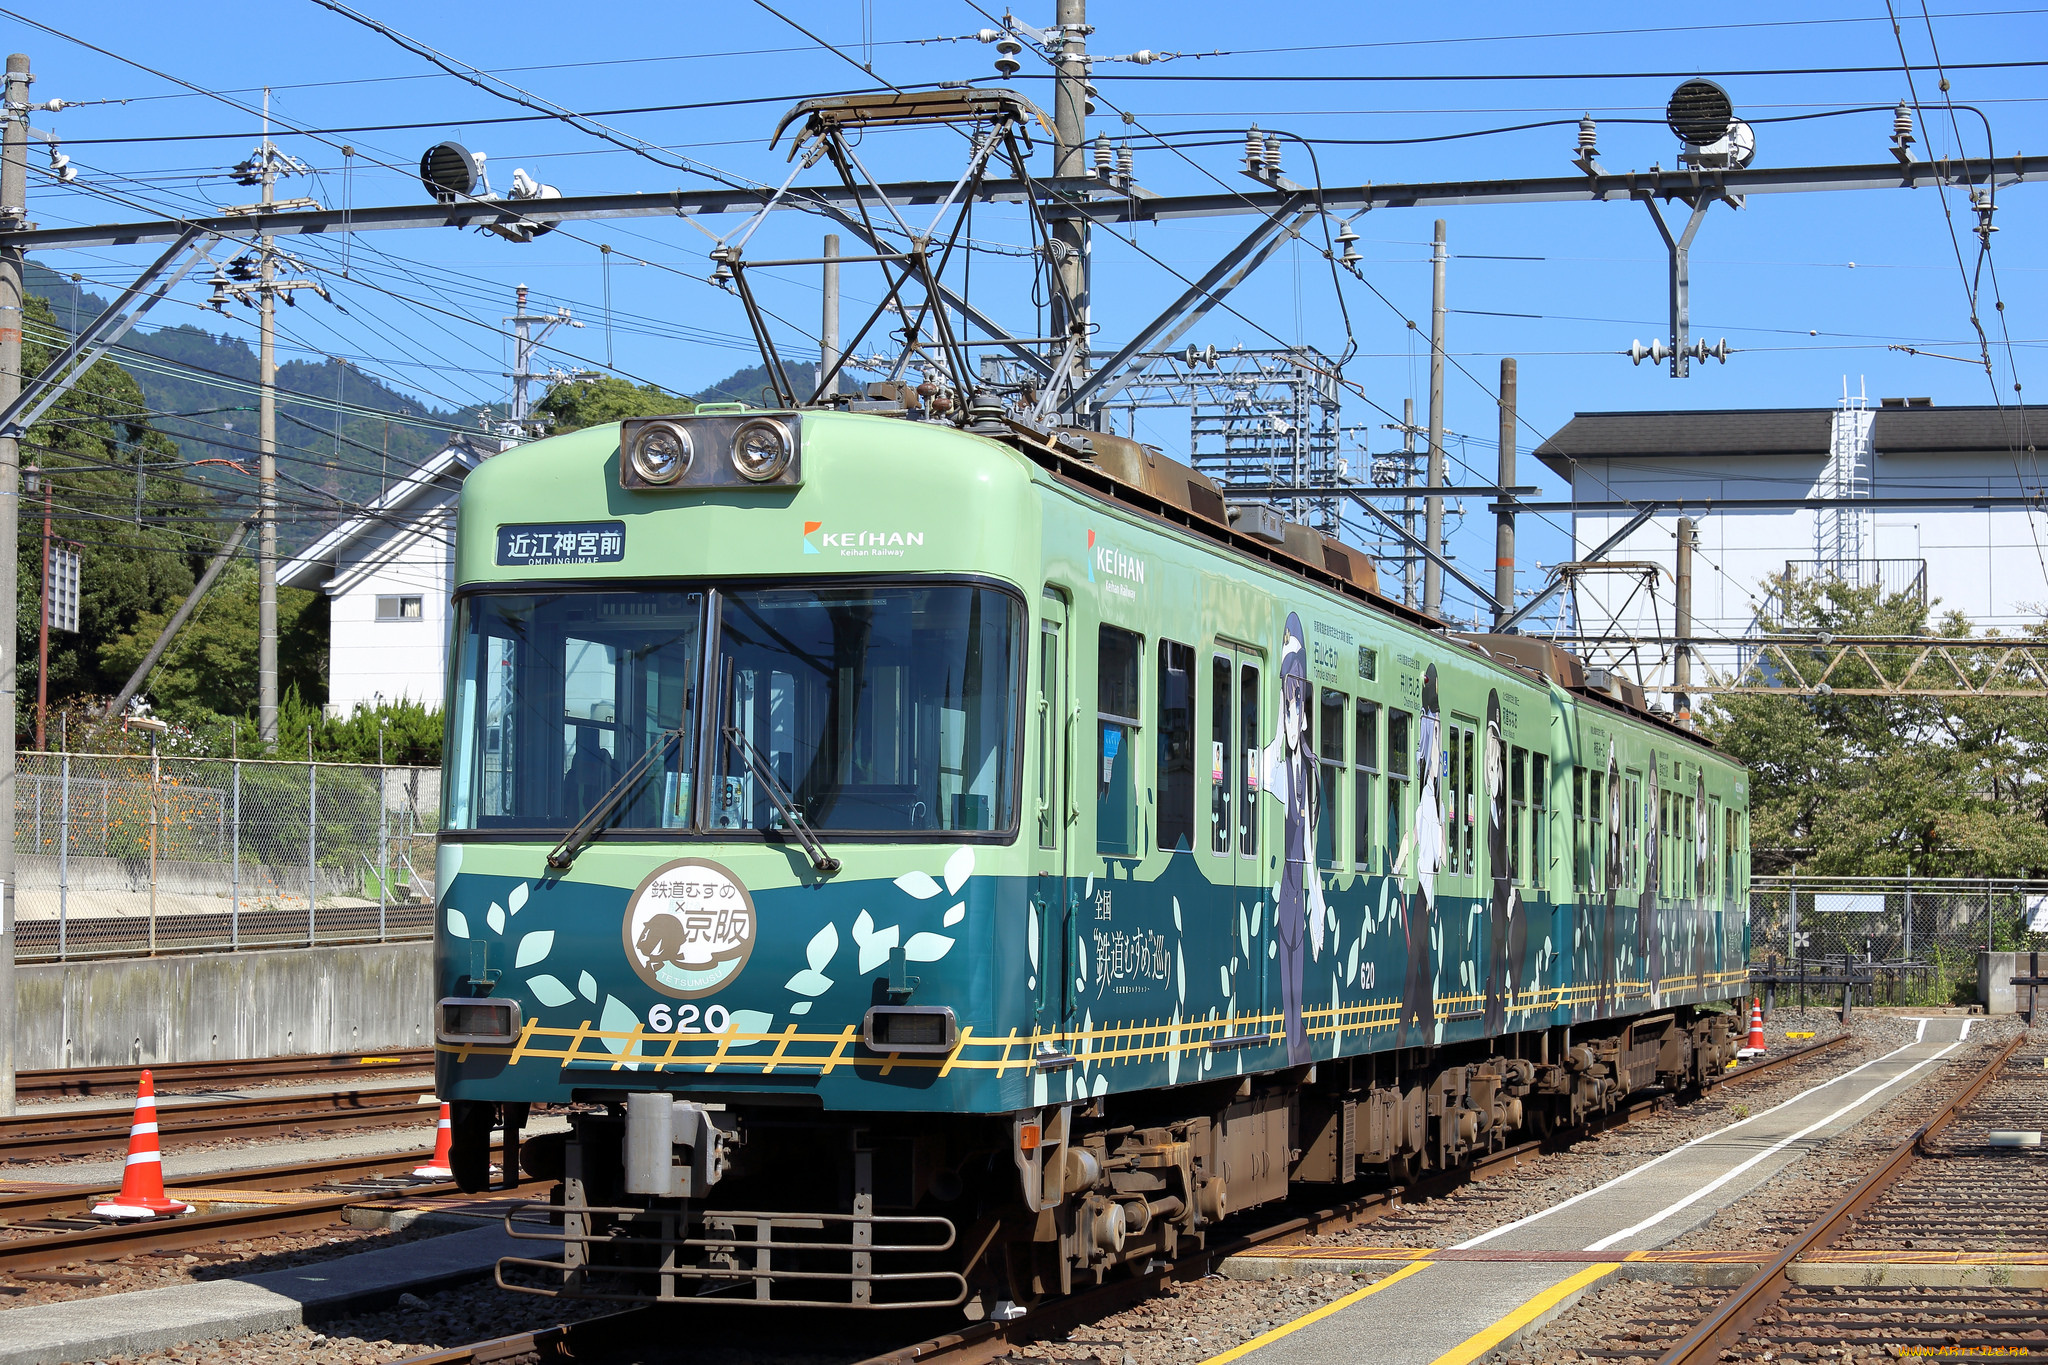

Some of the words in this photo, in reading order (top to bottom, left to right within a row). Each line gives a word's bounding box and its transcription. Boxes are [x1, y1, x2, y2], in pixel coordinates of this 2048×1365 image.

[507, 530, 622, 558] 近江神宮前
[822, 530, 924, 547] KEIHAN
[840, 548, 869, 557] Keihan
[871, 547, 904, 557] Railway
[1097, 545, 1145, 585] KEIHAN
[650, 880, 736, 899] 鉄道むすめ
[1094, 889, 1112, 921] 全国
[685, 907, 749, 944] 京阪
[660, 970, 724, 987] TETSUMUSU
[1360, 961, 1375, 990] 620
[648, 1003, 730, 1034] 620
